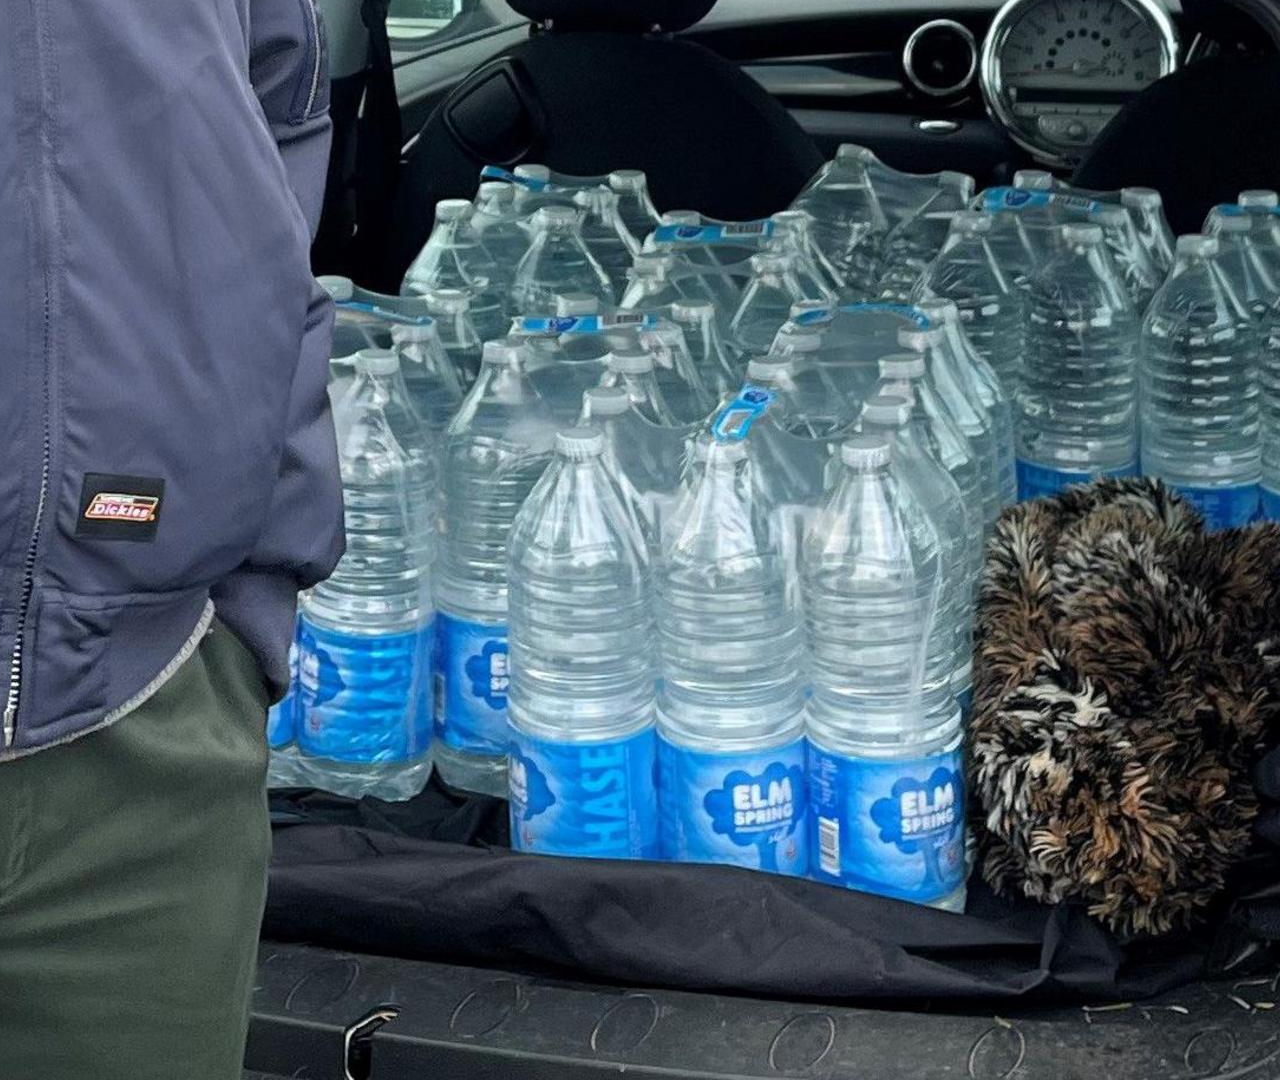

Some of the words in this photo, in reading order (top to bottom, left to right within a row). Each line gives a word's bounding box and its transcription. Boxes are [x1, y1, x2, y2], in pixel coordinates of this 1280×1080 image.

[93, 503, 149, 517] Dickies
[733, 776, 792, 811] ELM
[900, 782, 955, 817] ELM
[734, 803, 794, 826] SPRING
[900, 807, 956, 834] SPRING
